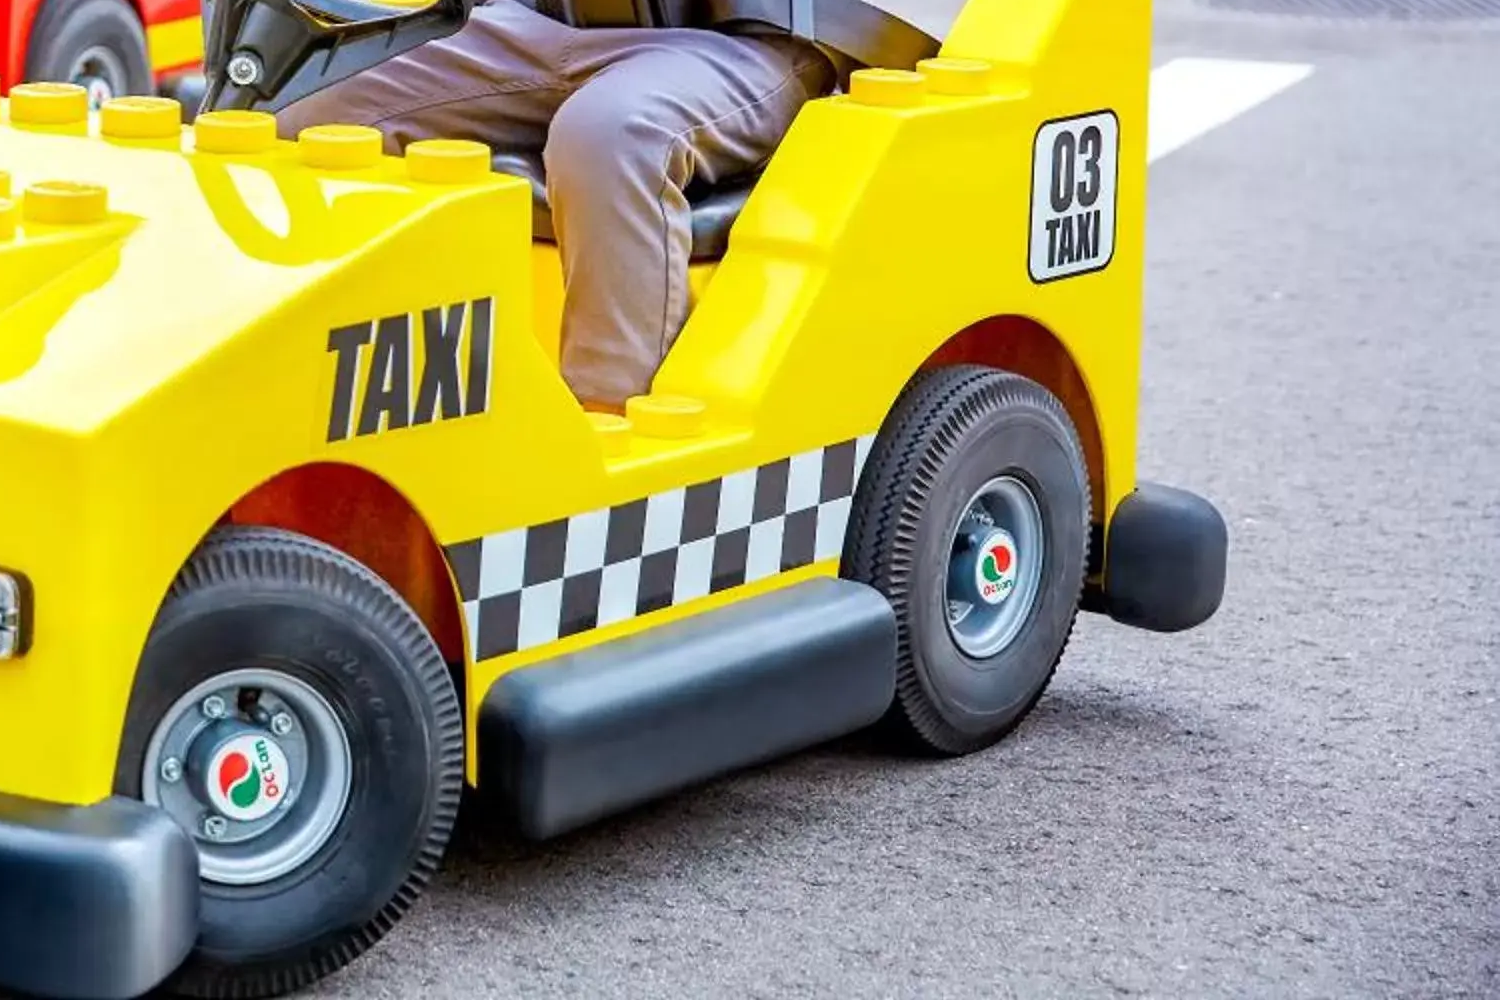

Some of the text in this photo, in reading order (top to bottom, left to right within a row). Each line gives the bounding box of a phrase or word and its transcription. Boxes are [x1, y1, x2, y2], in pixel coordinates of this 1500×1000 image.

[1050, 125, 1102, 213] 03
[1045, 209, 1101, 268] TAXI
[326, 296, 493, 444] TAXI
